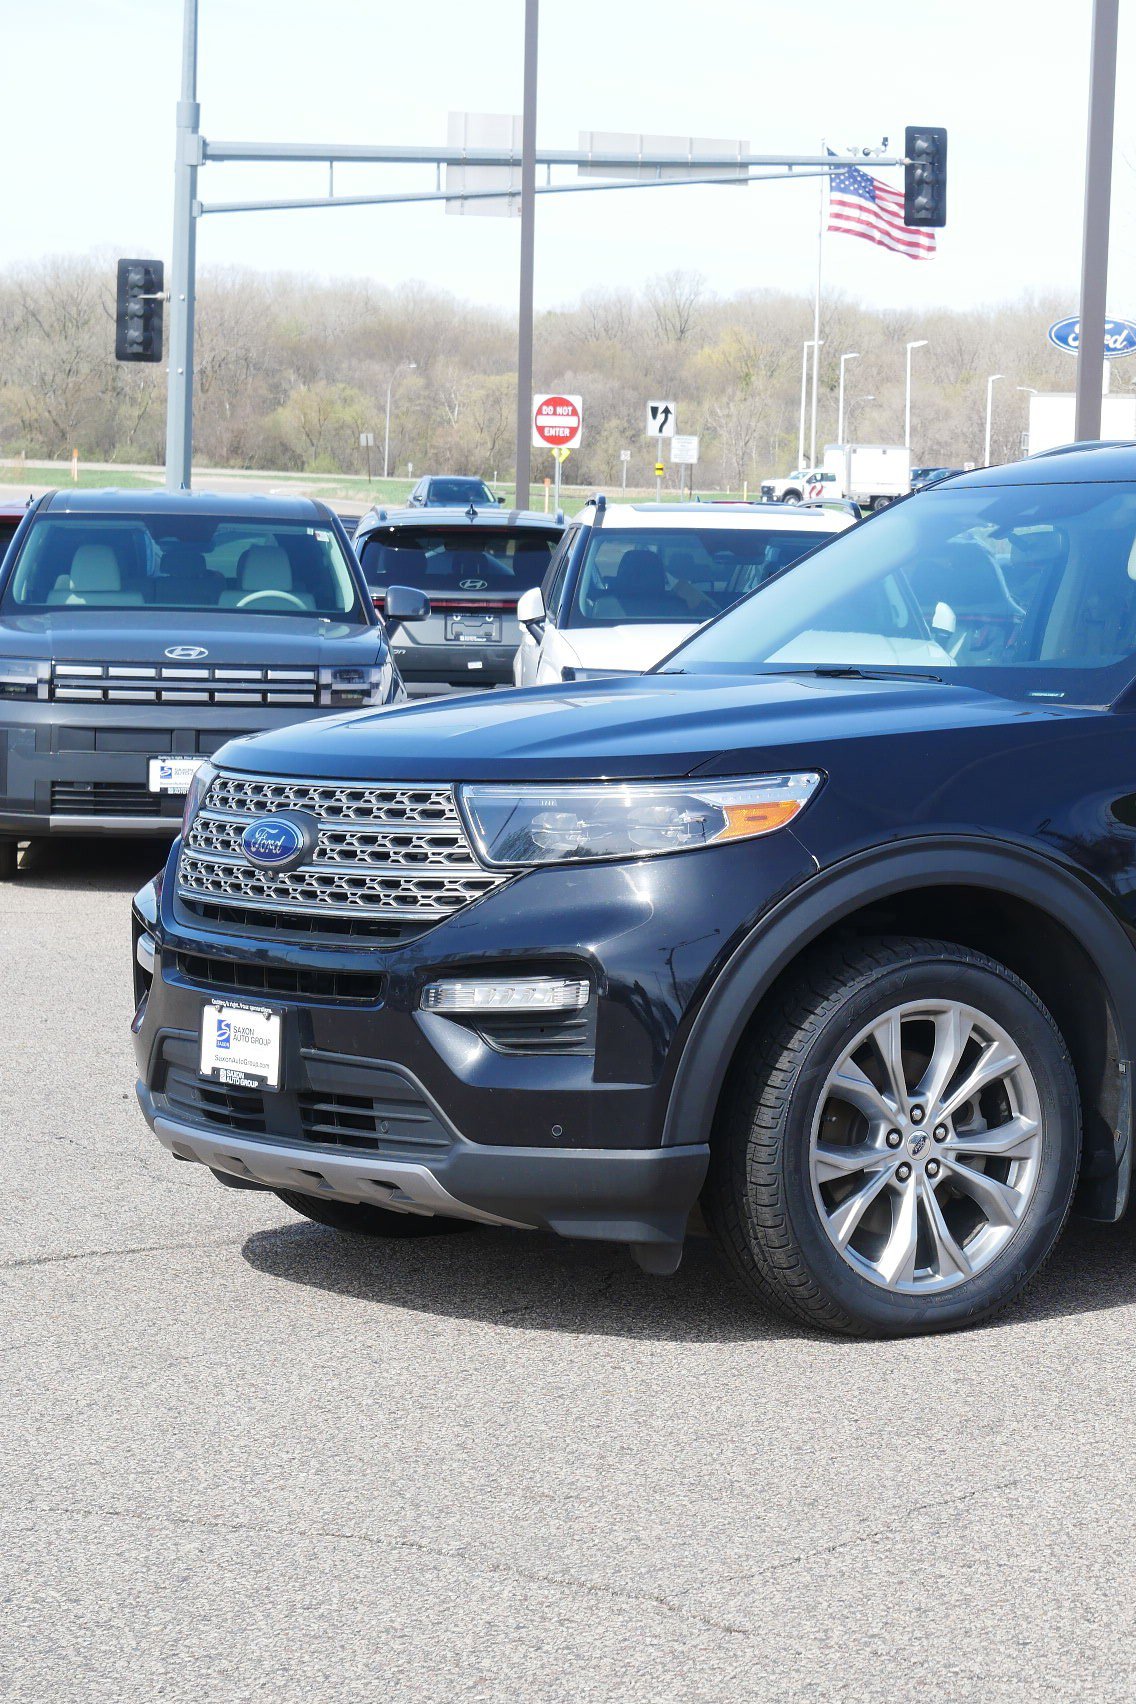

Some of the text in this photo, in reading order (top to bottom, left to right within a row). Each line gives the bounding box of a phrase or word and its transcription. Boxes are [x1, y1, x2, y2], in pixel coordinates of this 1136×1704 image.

[542, 405, 572, 416] DO NOT
[544, 427, 570, 437] ENTER
[251, 827, 286, 854] Ford
[233, 1025, 255, 1036] SAXON
[232, 1034, 272, 1047] AUTO GROUP
